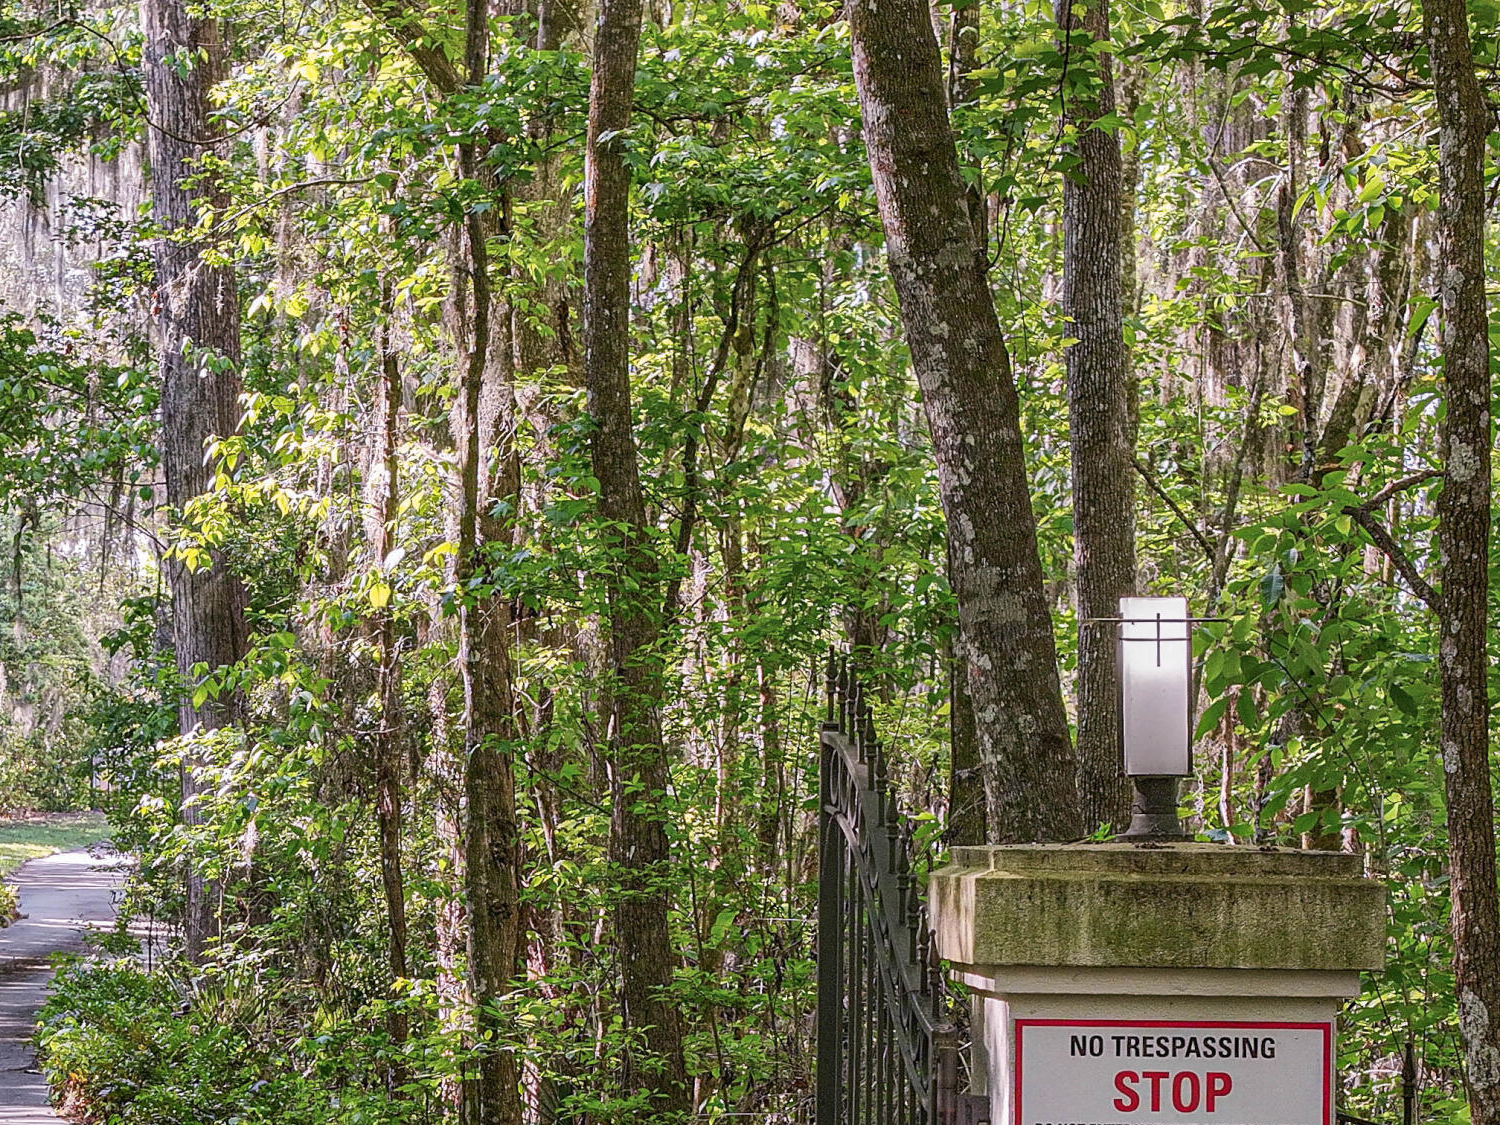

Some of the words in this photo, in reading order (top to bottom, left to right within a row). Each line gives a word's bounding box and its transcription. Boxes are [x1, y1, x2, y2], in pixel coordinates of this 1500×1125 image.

[1071, 1035, 1103, 1057] NO
[1111, 1036, 1275, 1058] TRESPASSING
[1114, 1071, 1232, 1113] STOP
